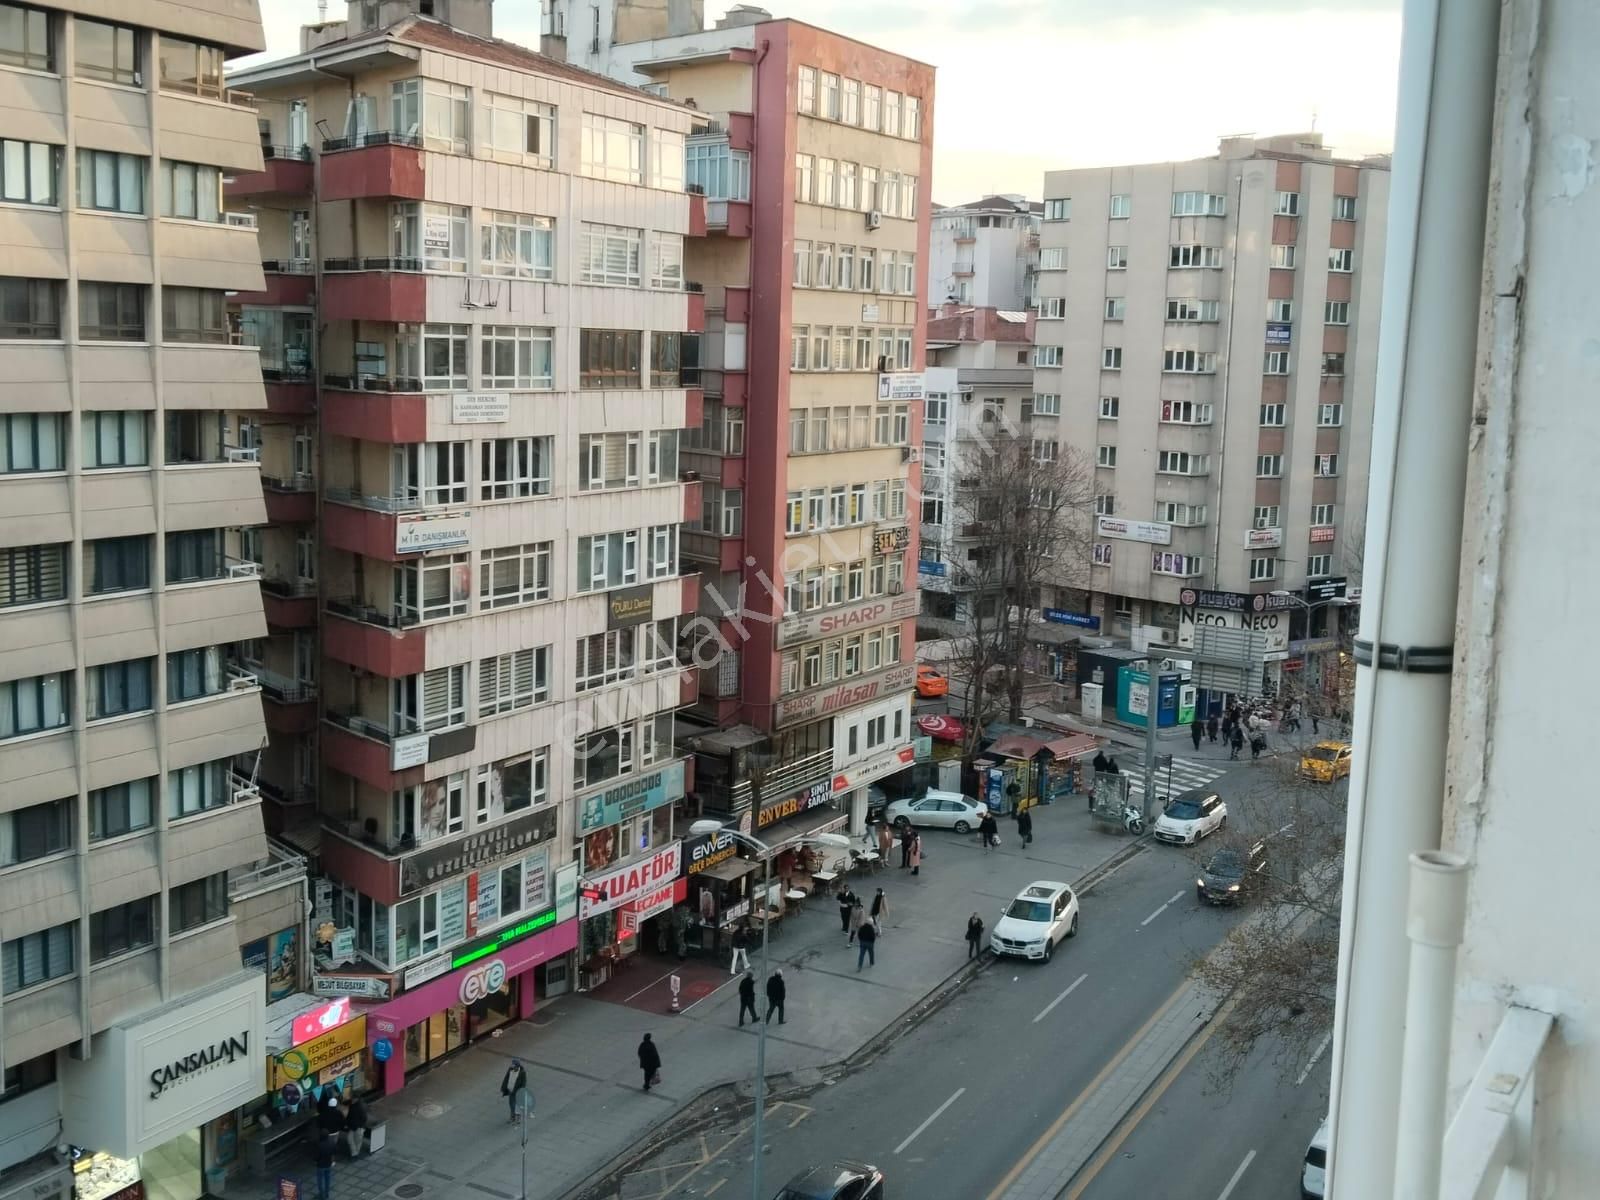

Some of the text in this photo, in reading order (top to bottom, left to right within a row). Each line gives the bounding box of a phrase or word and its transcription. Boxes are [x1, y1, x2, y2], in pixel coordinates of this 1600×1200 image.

[819, 603, 886, 633] SHARP
[1240, 613, 1279, 631] NECO
[882, 666, 914, 684] SHARP
[783, 694, 817, 715] SHARP
[821, 681, 879, 713] mitasan
[758, 798, 798, 827] ENVER
[692, 833, 734, 860] ENVER
[592, 851, 675, 905] KUAFÖR
[636, 885, 673, 911] ECZANE
[462, 963, 505, 1003] eve
[150, 1030, 250, 1100] SANSALAN
